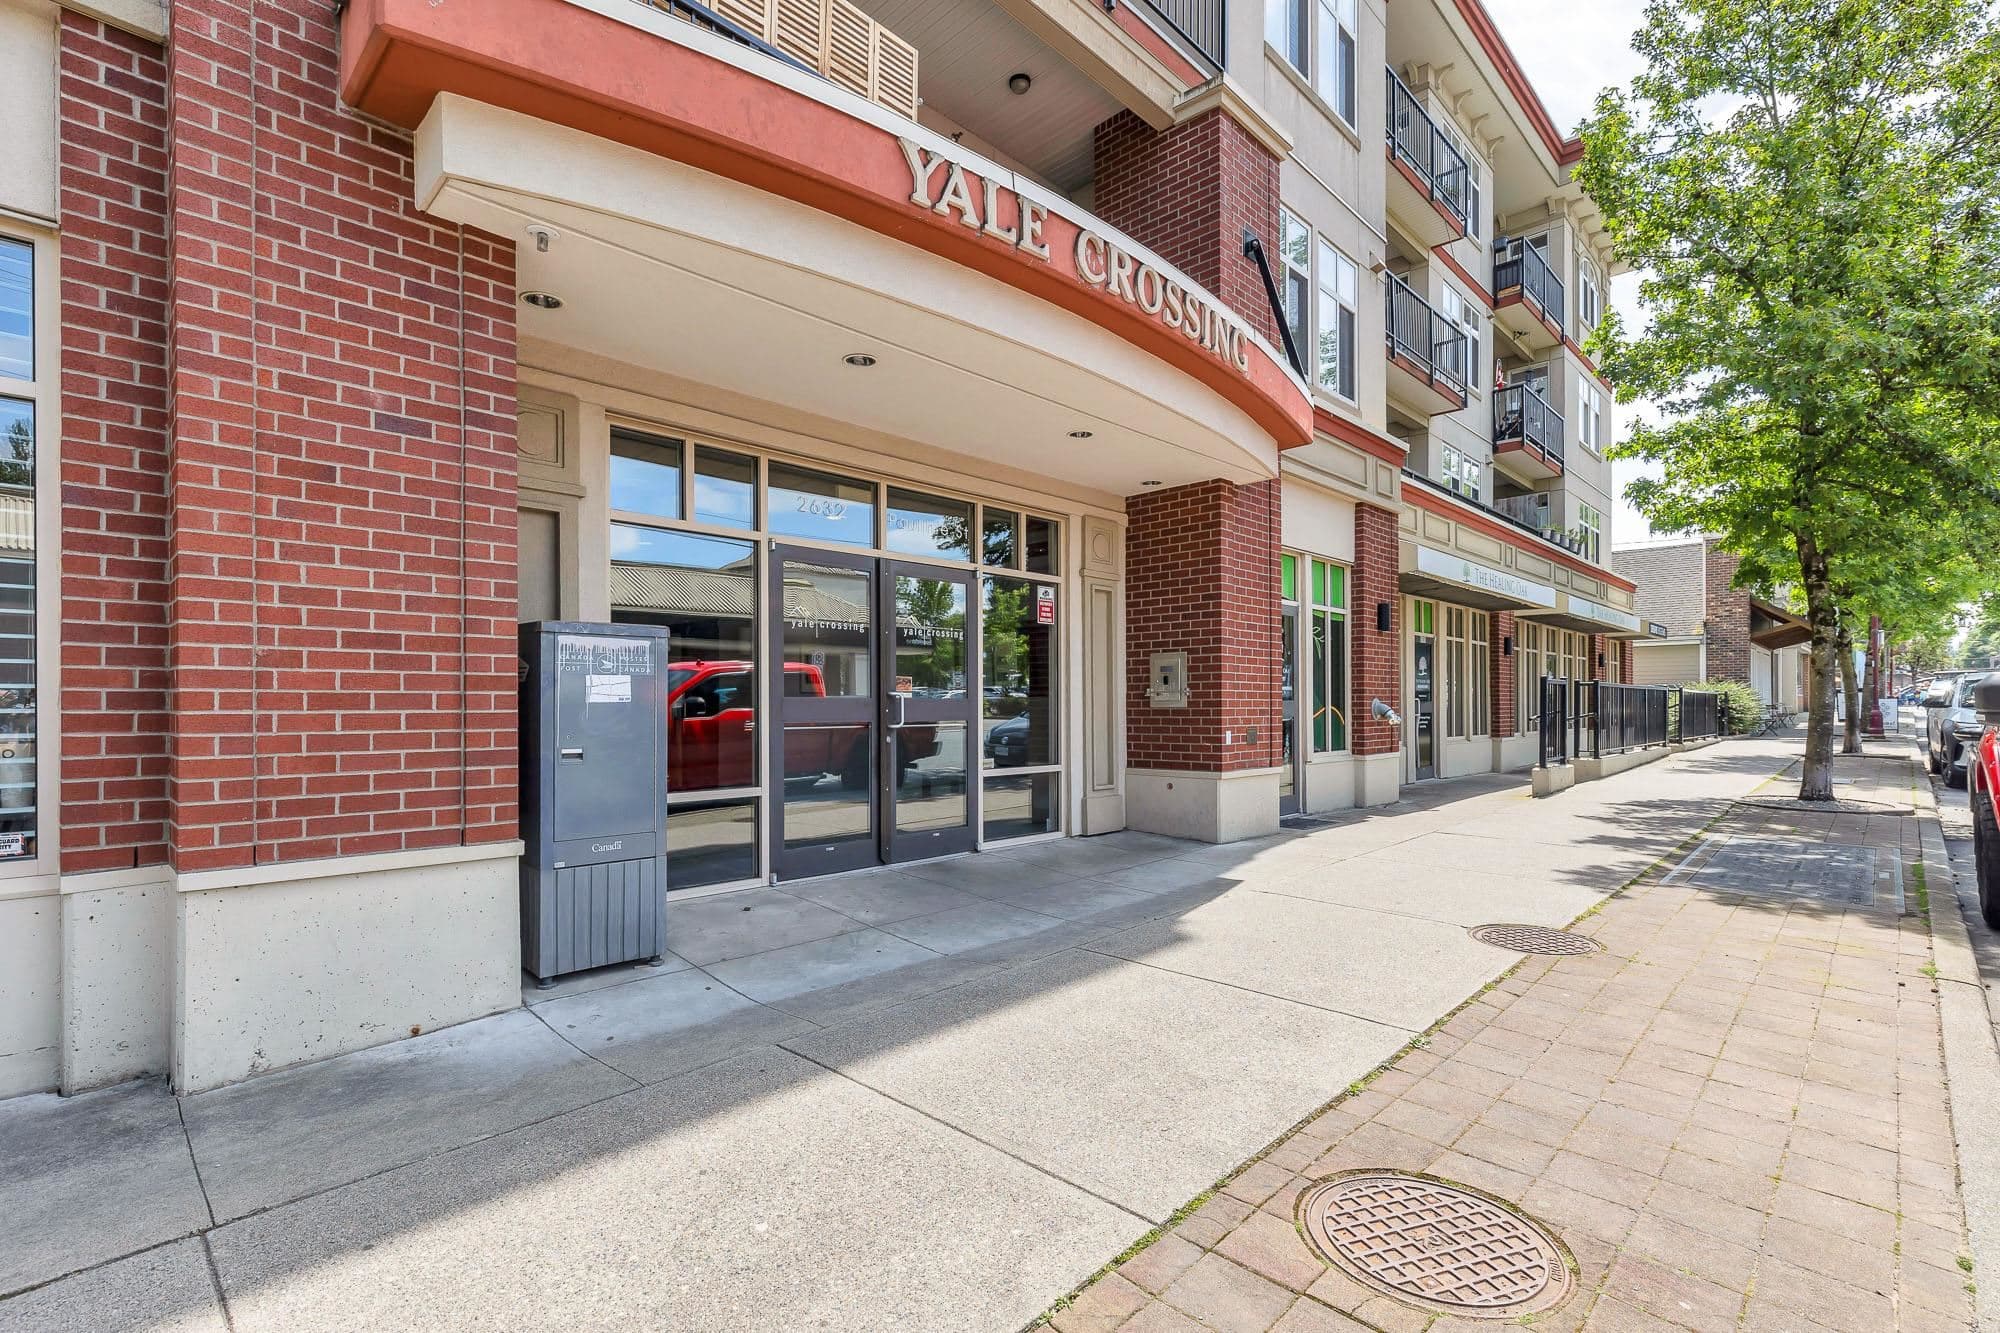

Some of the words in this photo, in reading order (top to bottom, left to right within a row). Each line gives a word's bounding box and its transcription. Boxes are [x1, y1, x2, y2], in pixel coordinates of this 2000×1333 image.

[898, 135, 1050, 261] YALE
[1074, 228, 1250, 377] CROSSING
[1474, 567, 1488, 586] THE
[1490, 572, 1515, 594] HEALING
[791, 619, 815, 630] yale
[819, 619, 865, 634] crossing
[903, 626, 924, 637] yale
[926, 627, 964, 641] crossing
[592, 840, 622, 852] Canada
